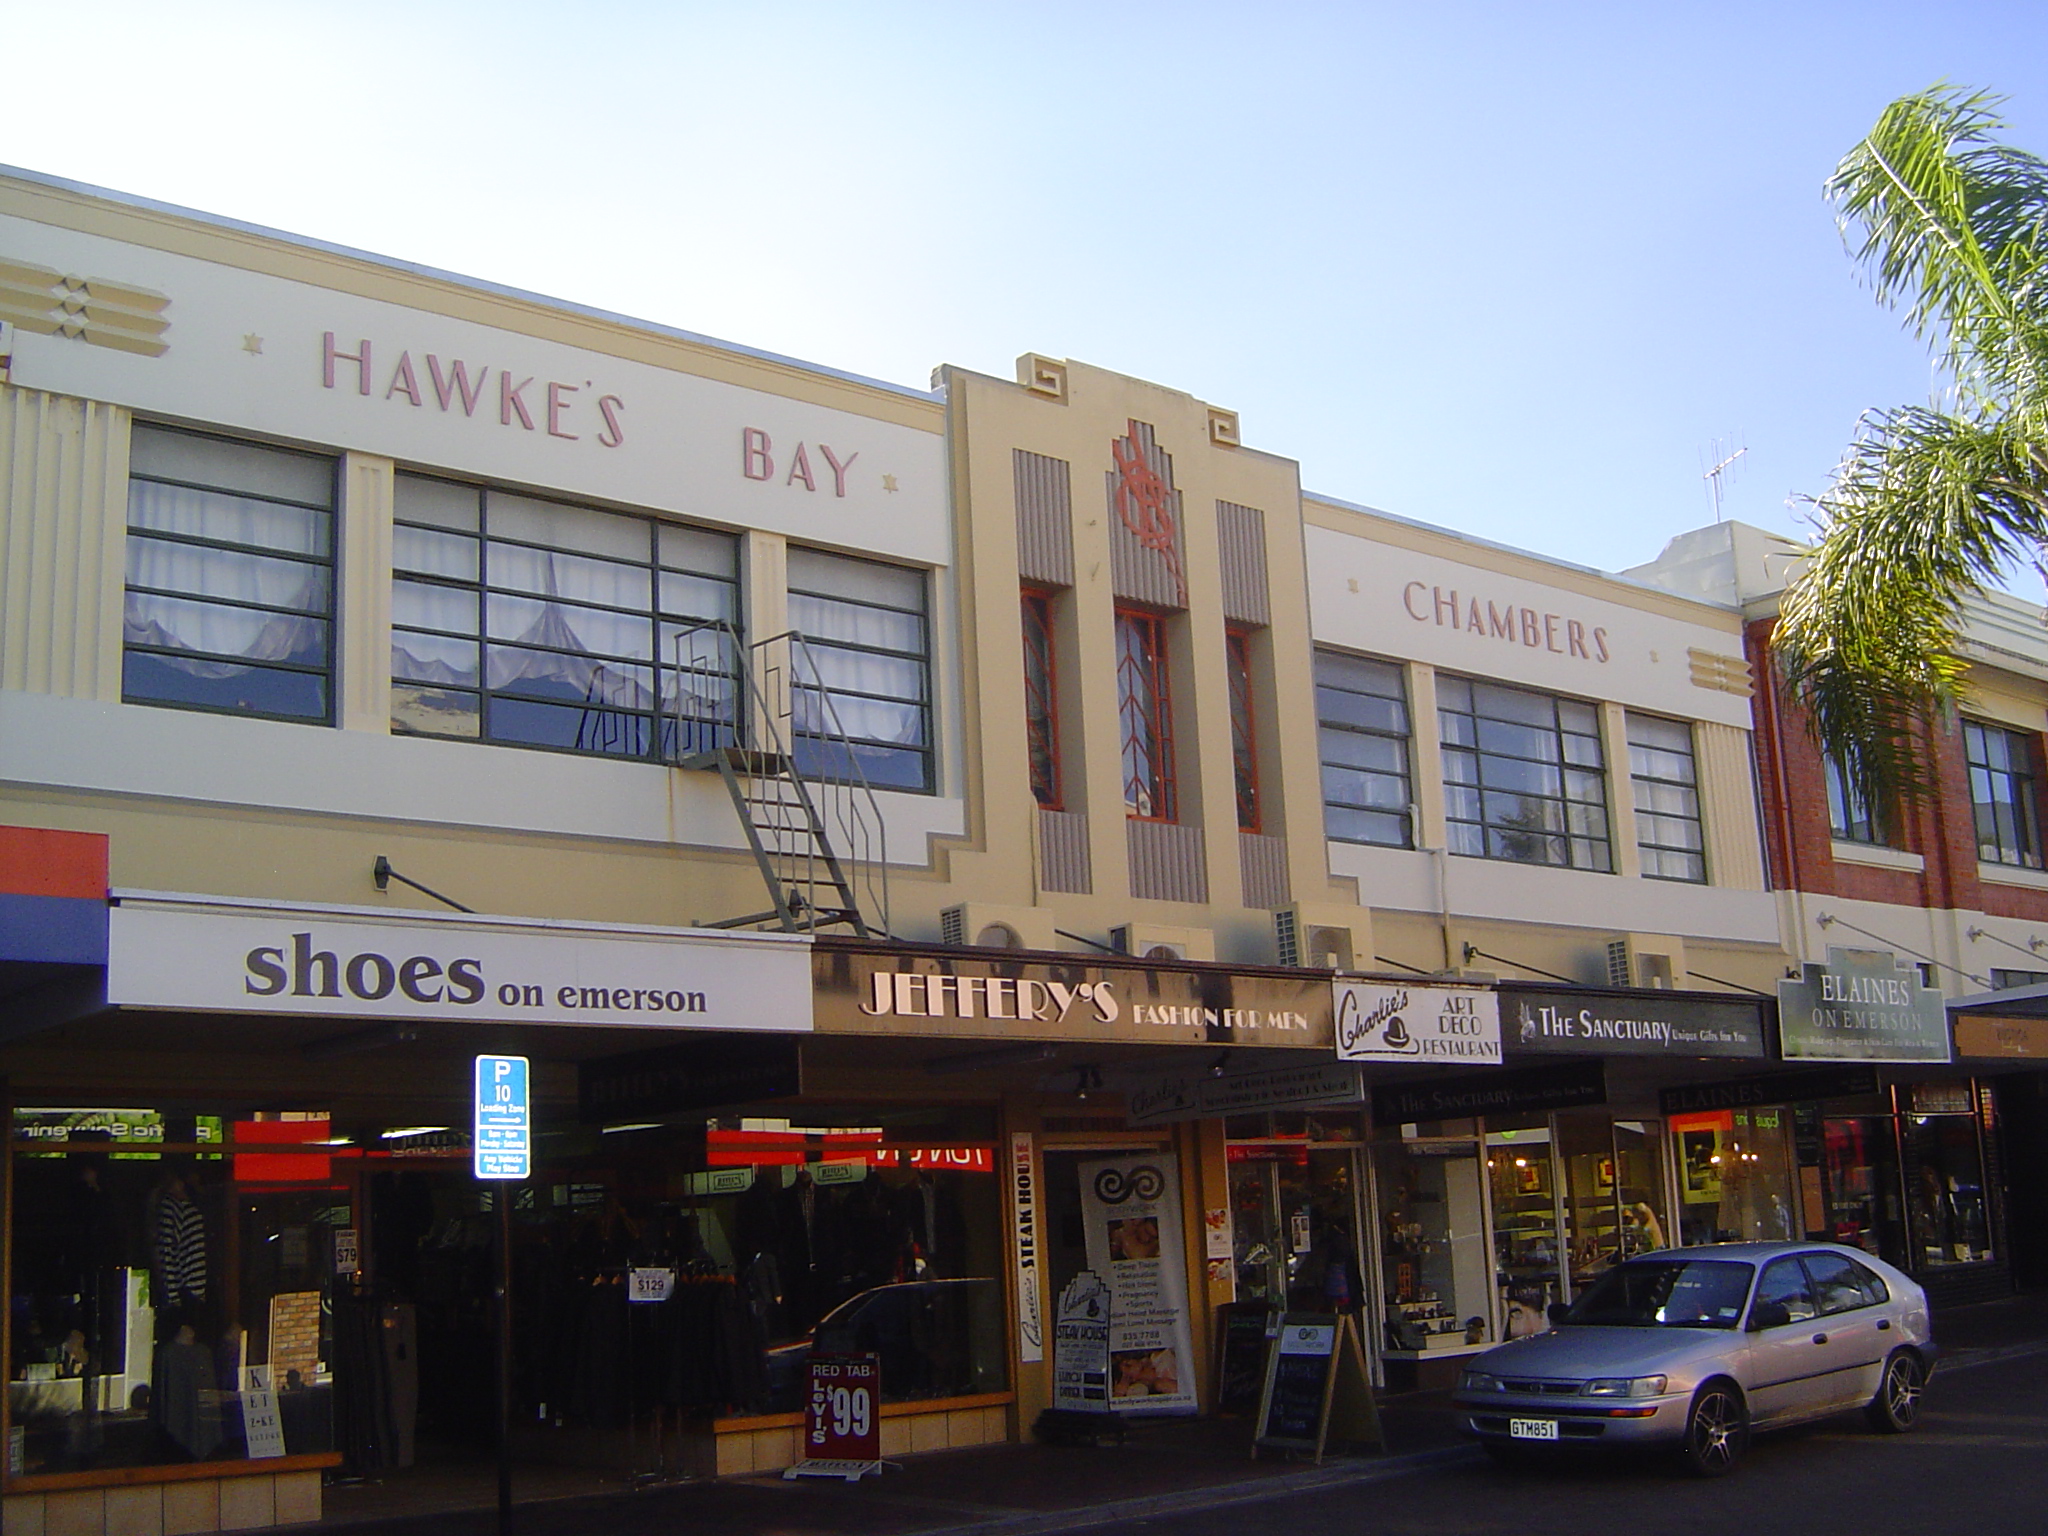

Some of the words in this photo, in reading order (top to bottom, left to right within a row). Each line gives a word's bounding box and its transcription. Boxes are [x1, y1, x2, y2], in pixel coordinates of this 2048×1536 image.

[323, 330, 625, 449] HAWKE'S
[743, 426, 860, 498] BAY
[1403, 581, 1610, 664] CHAMBERS
[245, 932, 485, 1005] shoes
[497, 979, 545, 1008] on
[557, 983, 707, 1013] emerson
[859, 971, 1119, 1024] JEFFERY'S
[1133, 1003, 1219, 1028] FASHION
[1223, 1008, 1262, 1030] FOR
[1266, 1010, 1308, 1031] MEN
[1821, 974, 1910, 1007] ELAINES
[1442, 995, 1475, 1016] ART
[1340, 988, 1408, 1051] Charlie's
[1438, 1015, 1482, 1036] DECO
[1812, 1007, 1837, 1029] ON
[1843, 1009, 1922, 1031] EMERSON
[1423, 1037, 1501, 1057] RESTAURANT
[495, 1061, 511, 1083] P
[495, 1085, 511, 1102] 10
[1665, 1083, 1764, 1110] ELAINES
[481, 1104, 507, 1114] Loading
[508, 1104, 526, 1114] Zone
[483, 1155, 497, 1164] Any
[498, 1155, 523, 1164] Vehicle
[1017, 1142, 1031, 1205] HOUSE
[1020, 1210, 1035, 1268] STEAK
[337, 1248, 357, 1263] $79
[638, 1279, 664, 1291] $129
[1130, 1300, 1153, 1309] Sports
[1057, 1325, 1080, 1340] STEAK
[1080, 1325, 1107, 1341] HOUSE
[250, 1370, 262, 1388] K
[812, 1364, 840, 1377] RED
[845, 1364, 870, 1377] TAB
[250, 1395, 258, 1408] E
[261, 1393, 269, 1407] T
[826, 1384, 871, 1437] $99
[1512, 1421, 1554, 1437] GTM851
